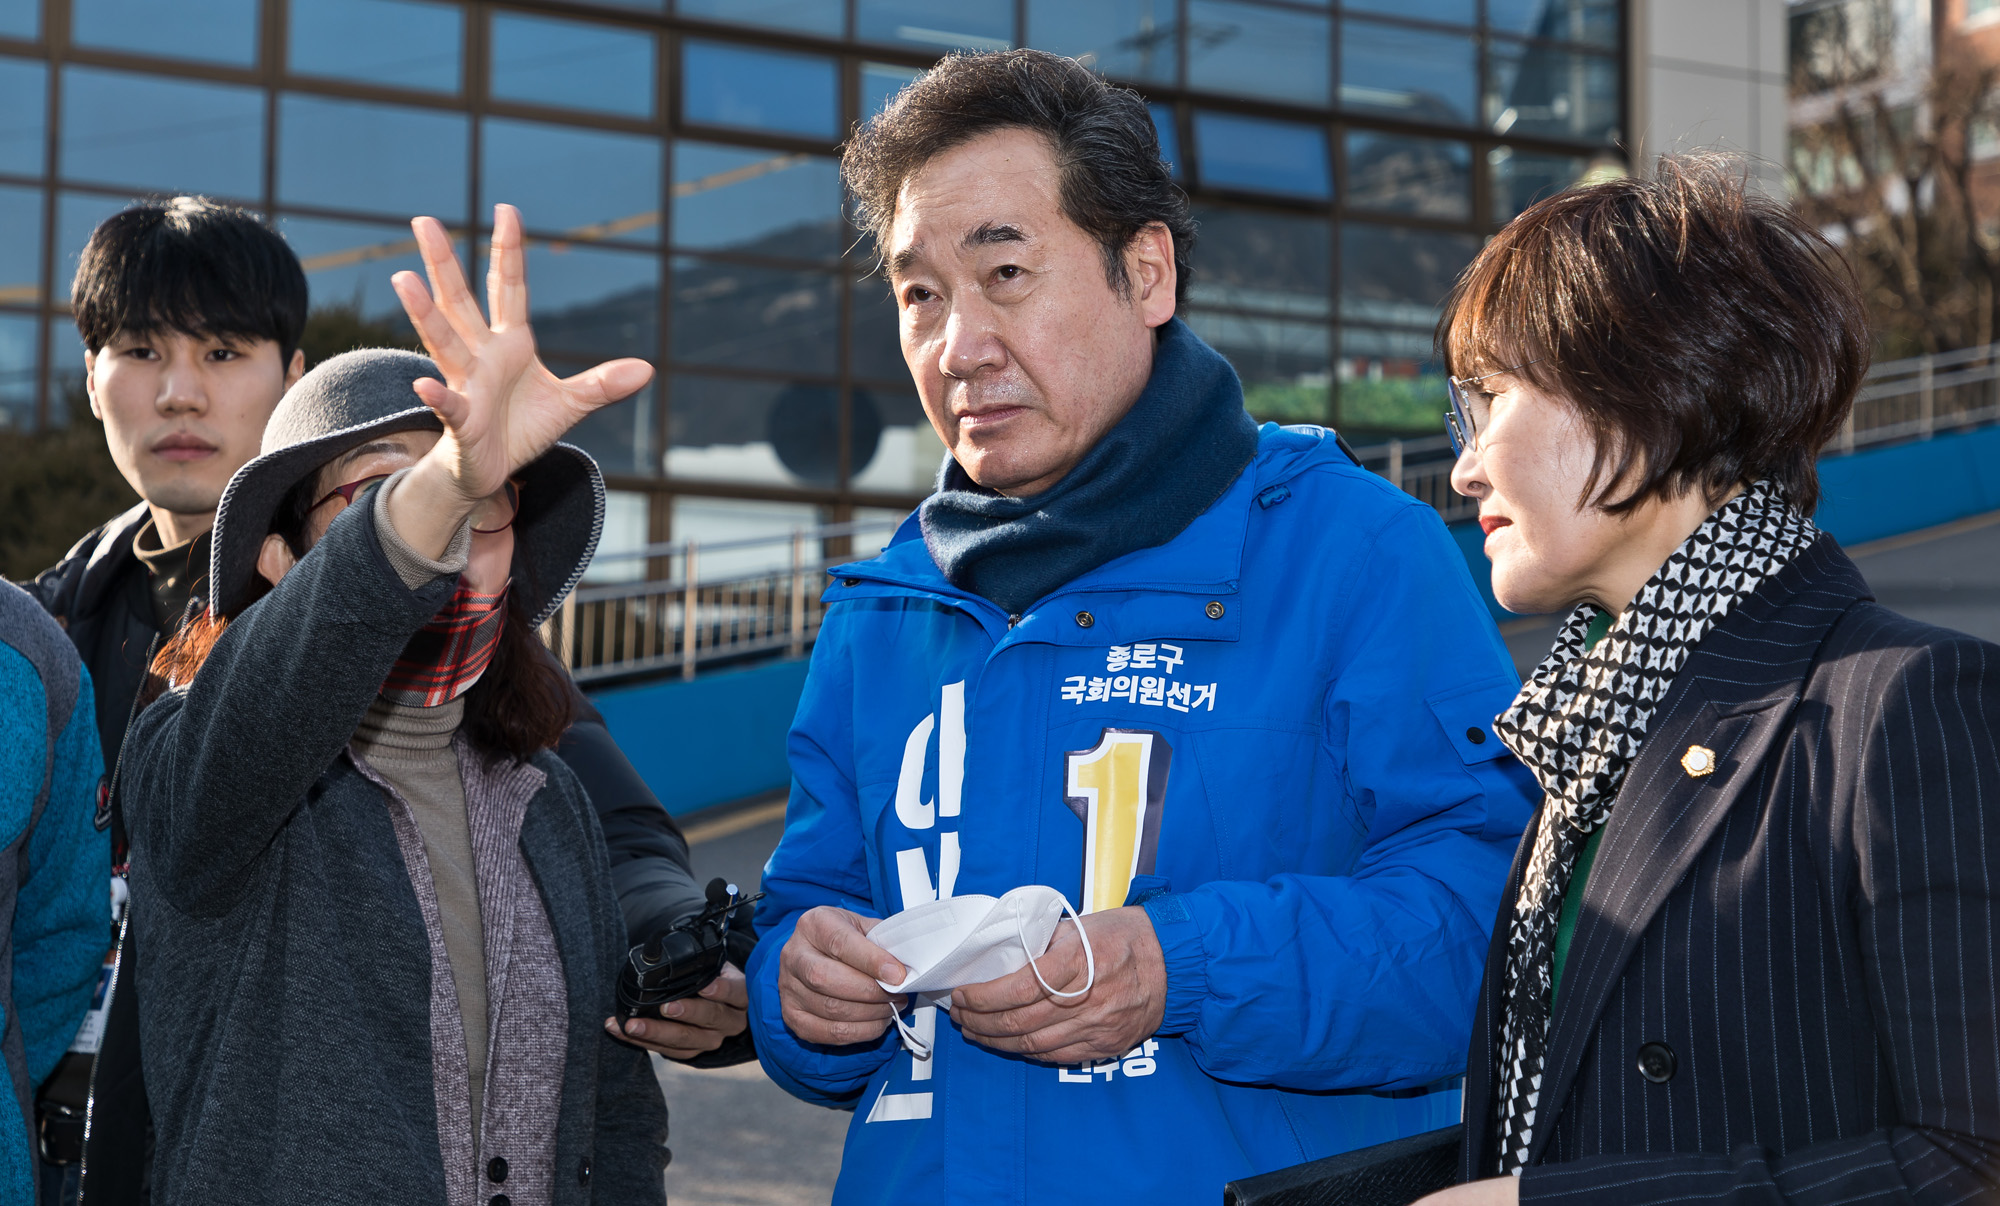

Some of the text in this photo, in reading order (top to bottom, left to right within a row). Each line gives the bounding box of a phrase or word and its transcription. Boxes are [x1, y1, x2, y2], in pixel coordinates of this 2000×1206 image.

[1106, 643, 1184, 674] 종로구
[1060, 675, 1218, 713] 국회의원선거
[1064, 728, 1172, 919] 1
